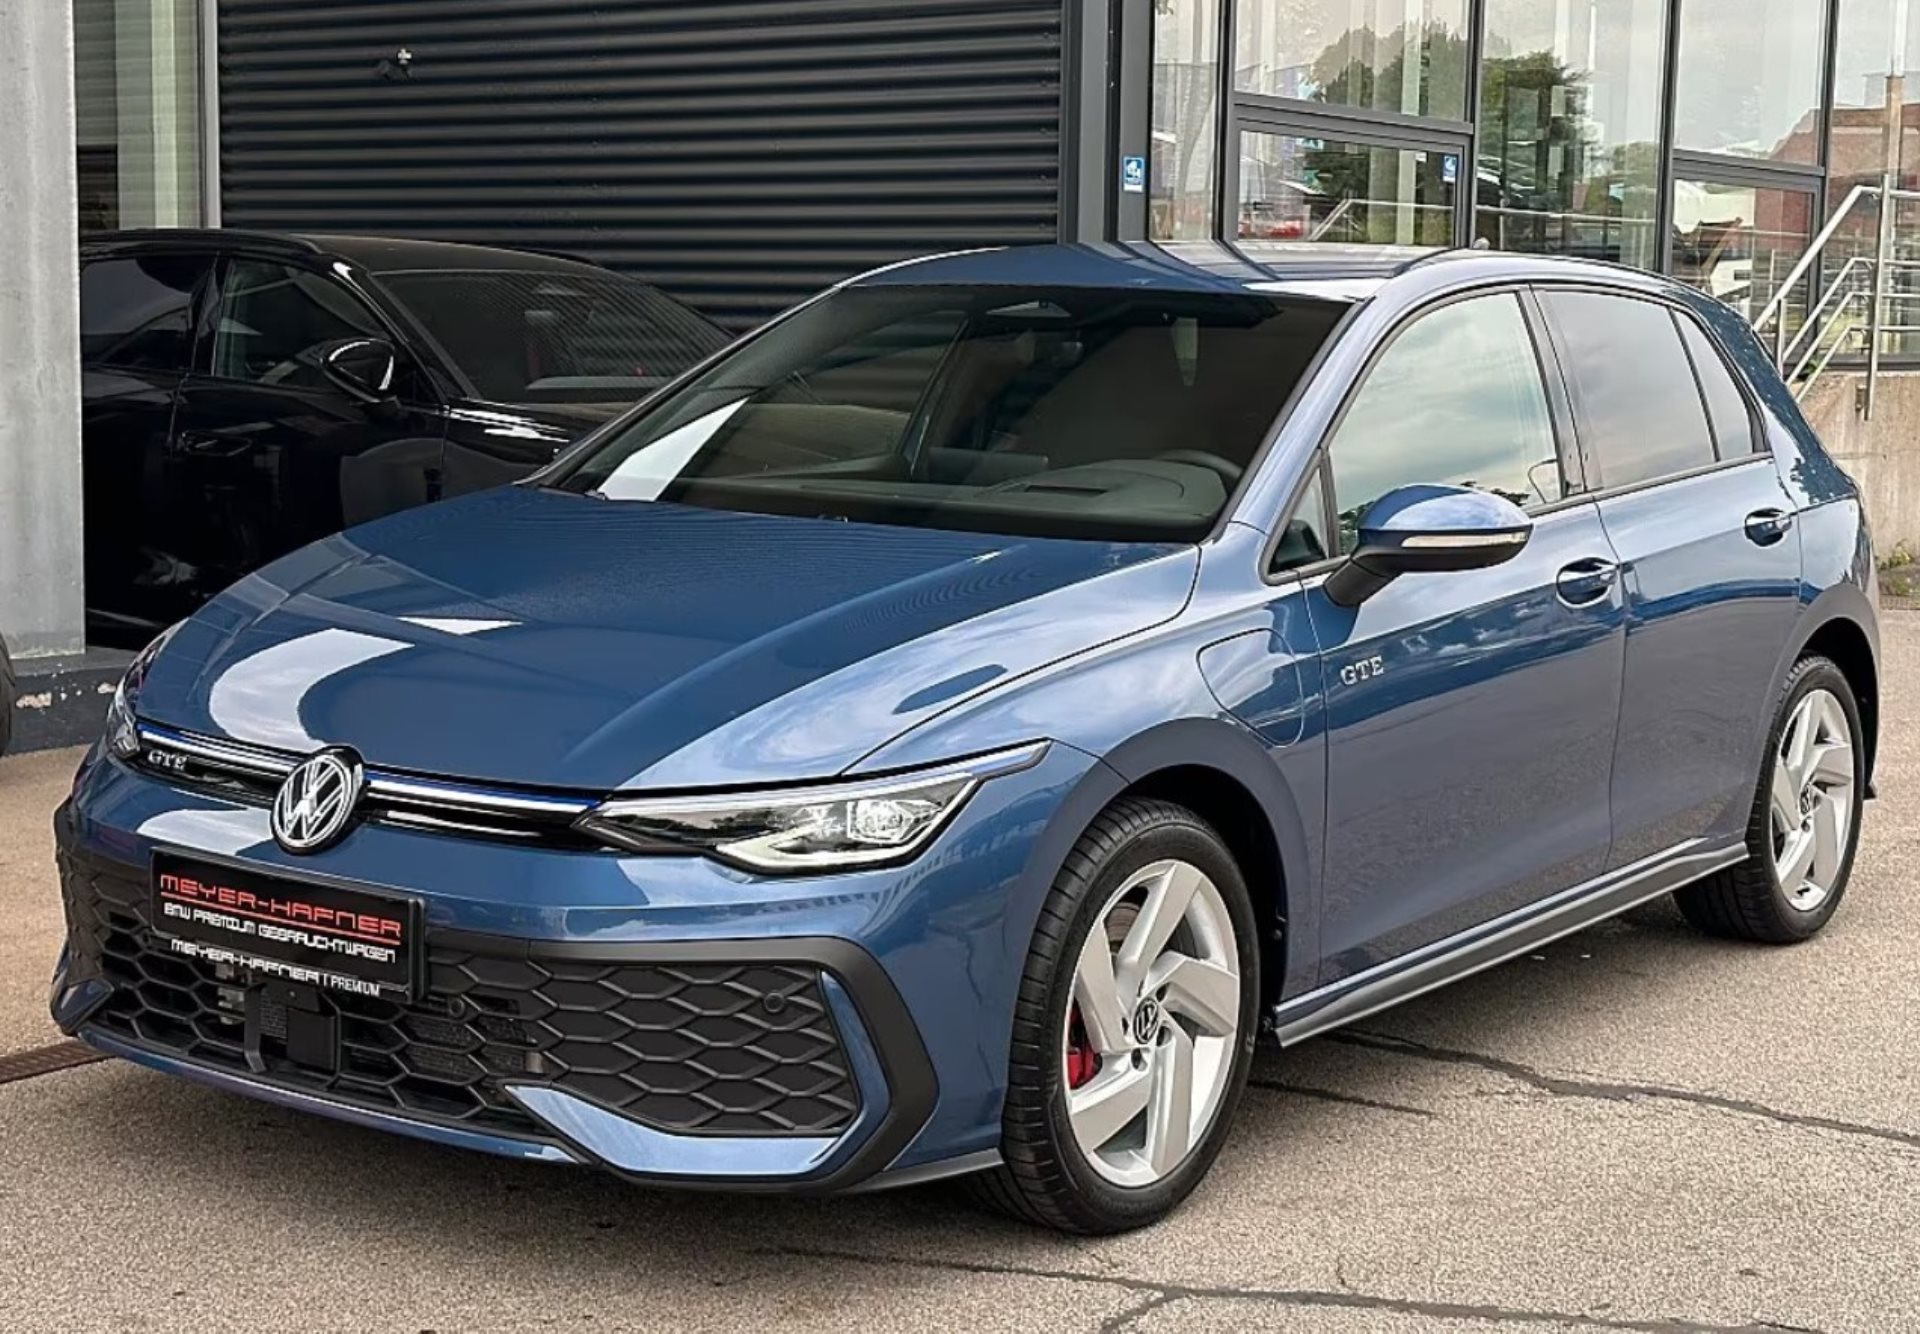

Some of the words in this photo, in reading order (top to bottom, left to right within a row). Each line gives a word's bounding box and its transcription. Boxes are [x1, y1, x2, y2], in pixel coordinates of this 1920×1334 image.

[1340, 655, 1384, 685] GTE
[148, 750, 188, 770] GTE
[160, 874, 401, 937] MEYER-HAFNER
[193, 908, 256, 935] PREMIUM
[258, 924, 396, 963] GEBRAUCHTWAGEN
[171, 938, 320, 985] MEYER-HAFNER
[330, 975, 380, 997] PREMIUM
